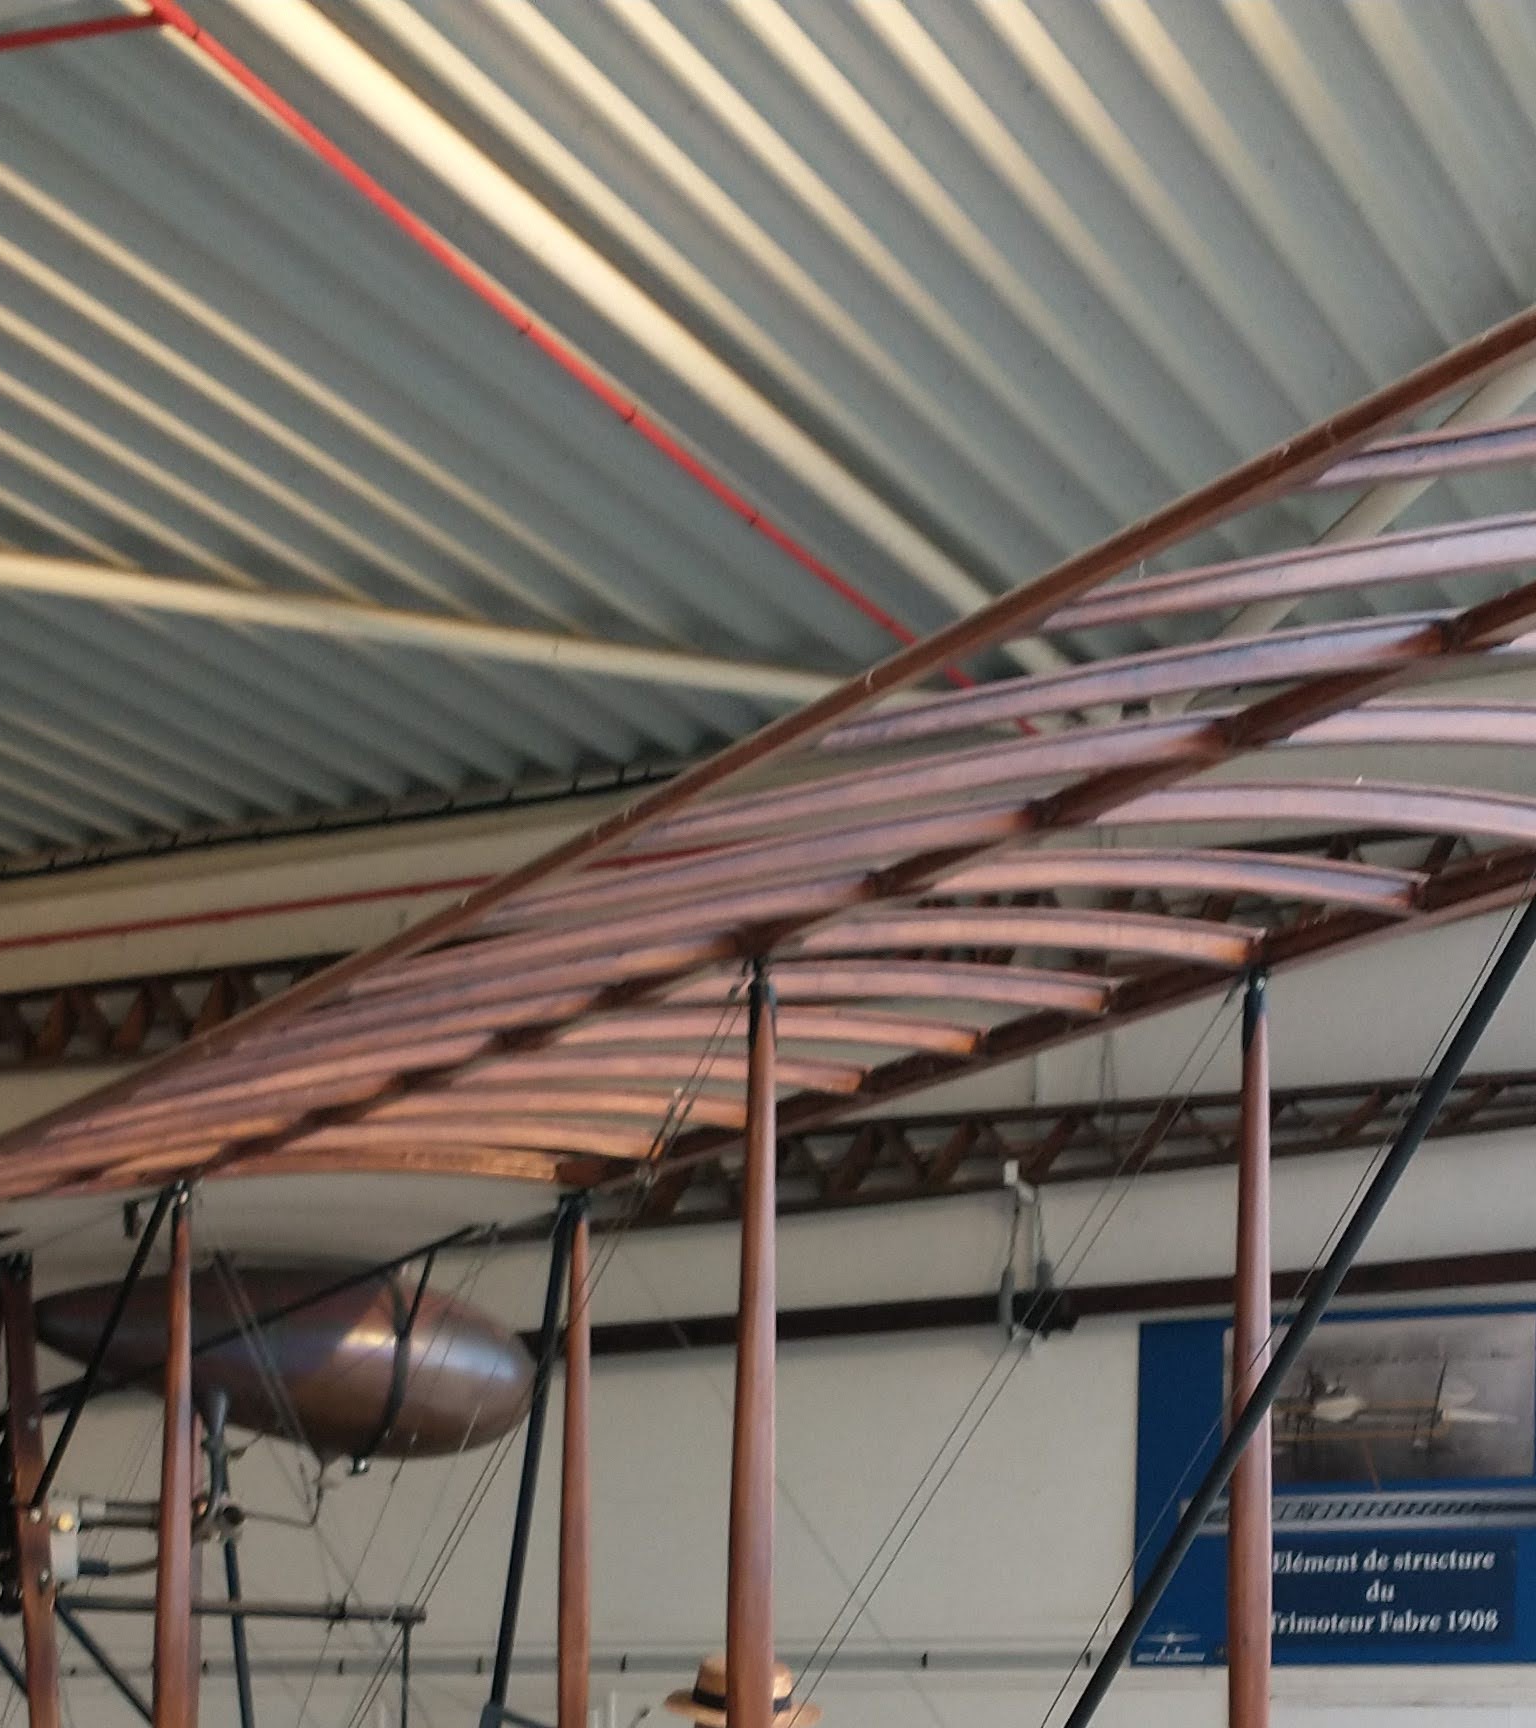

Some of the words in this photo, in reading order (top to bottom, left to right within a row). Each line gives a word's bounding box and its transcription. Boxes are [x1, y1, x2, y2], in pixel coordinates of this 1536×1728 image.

[1363, 1548, 1389, 1571] de
[1393, 1550, 1496, 1571] structure
[1365, 1578, 1396, 1602] du
[1379, 1608, 1442, 1633] Fabre
[1447, 1608, 1499, 1632] 1908
